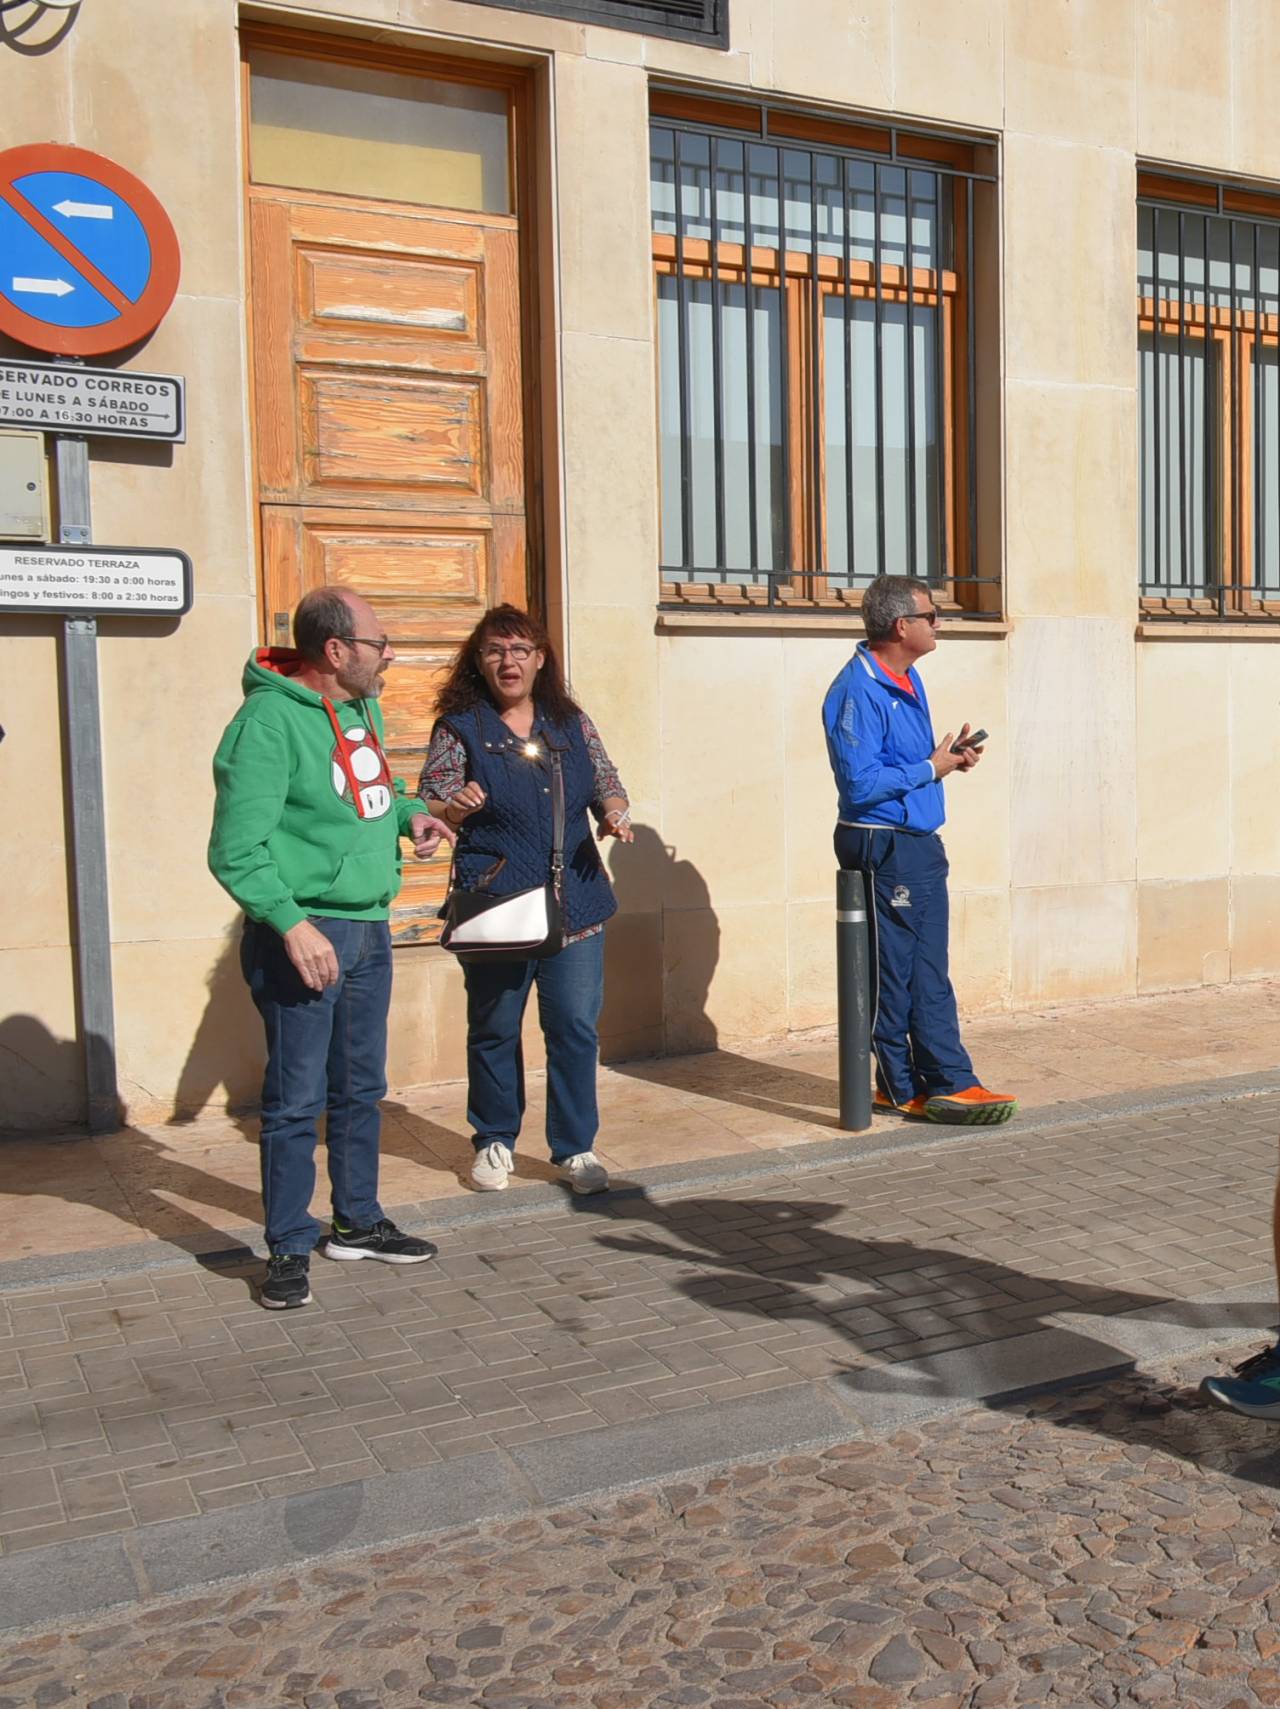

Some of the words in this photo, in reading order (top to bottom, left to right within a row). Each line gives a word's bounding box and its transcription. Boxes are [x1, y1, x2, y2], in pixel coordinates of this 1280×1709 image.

[85, 378, 169, 397] CORREOS
[16, 391, 66, 404] LUNES
[72, 396, 81, 406] A
[88, 395, 149, 412] SÁBADO
[0, 406, 34, 417] 7:00
[40, 409, 49, 419] A
[55, 410, 93, 422] 16:30
[97, 414, 148, 427] HORAS
[14, 556, 85, 567] RESERVADO
[88, 559, 140, 569] TERRAZA
[37, 573, 79, 583] sábado:
[83, 575, 111, 584] 19:30
[122, 576, 145, 585] 0:00
[147, 577, 176, 587] horas
[33, 591, 40, 599] y
[91, 591, 114, 600] 8:00
[125, 592, 148, 601] 2:30
[150, 593, 179, 602] horas
